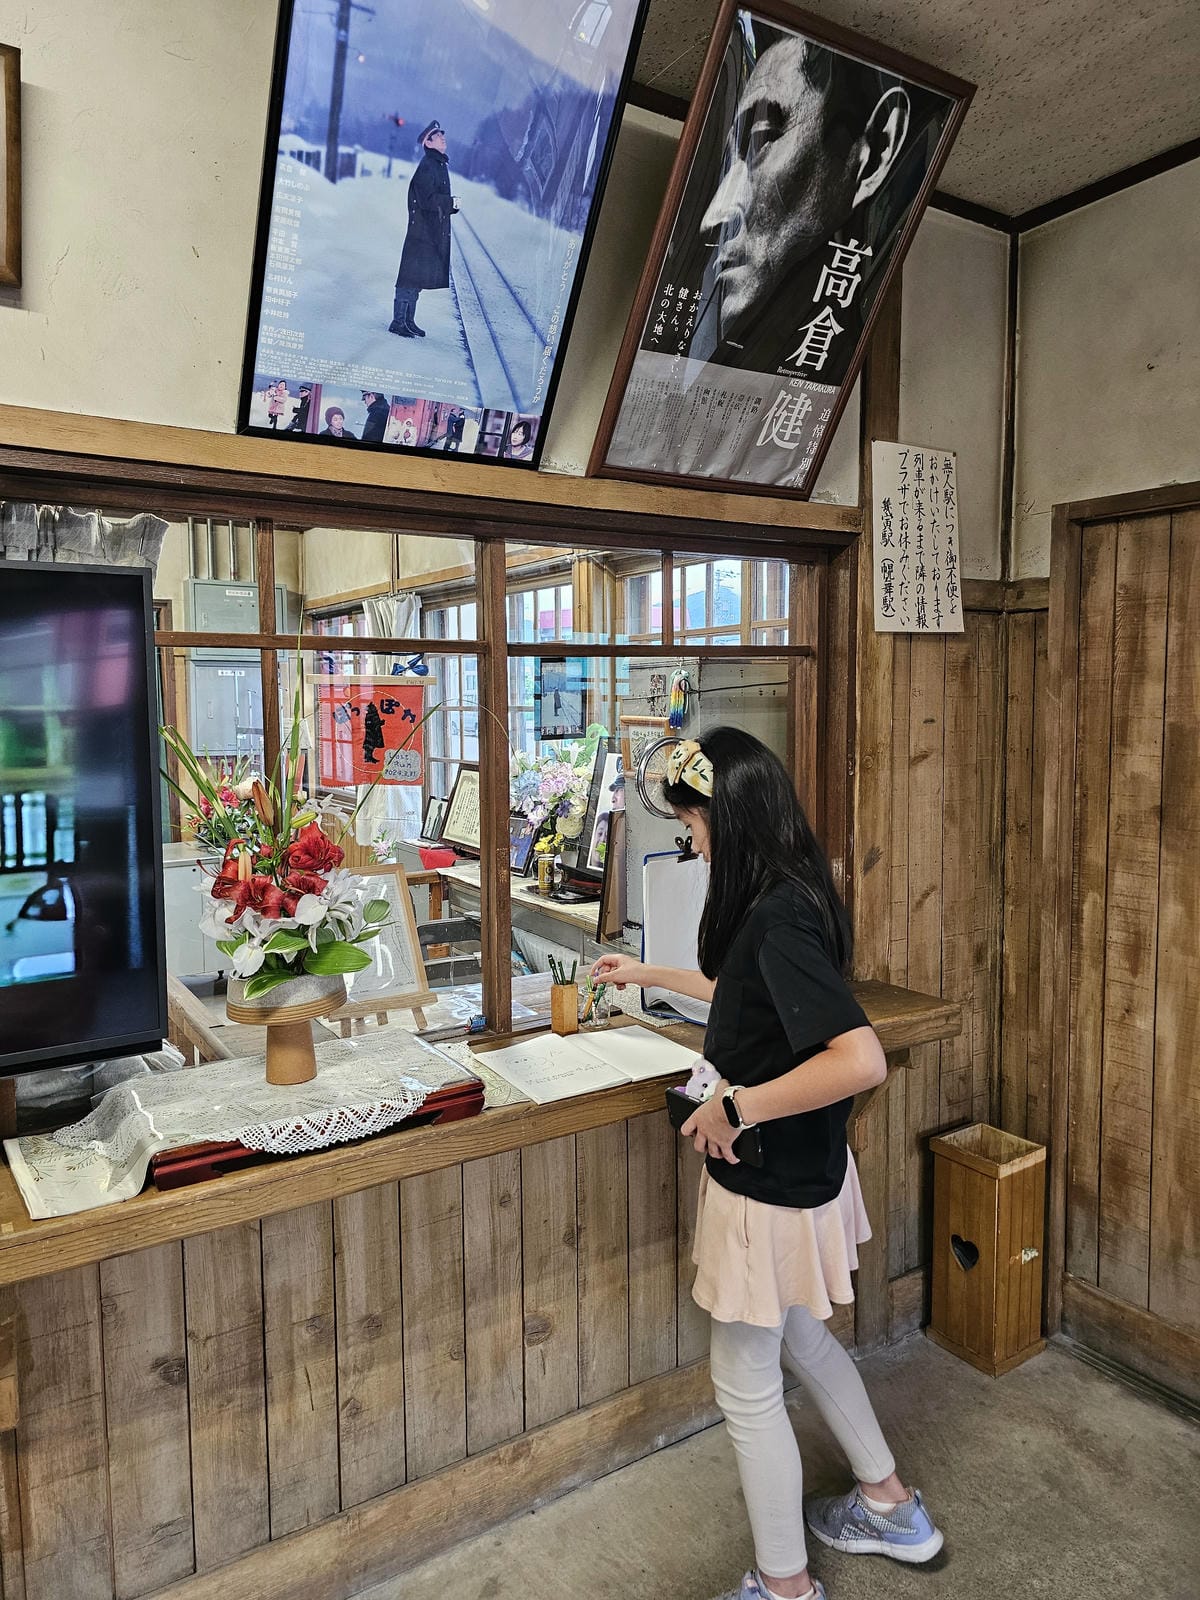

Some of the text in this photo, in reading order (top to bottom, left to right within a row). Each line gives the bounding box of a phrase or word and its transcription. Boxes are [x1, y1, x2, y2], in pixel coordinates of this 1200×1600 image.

[650, 283, 675, 344] 北の大地へ
[789, 378, 837, 395] KEN TAKAKURA
[756, 389, 813, 450] 健
[897, 449, 911, 627] プラザでお休みください
[912, 453, 929, 629] 列車が来るまで隣の情報
[928, 456, 944, 630] おかけいたしております
[941, 456, 959, 614] 無人駅につき御不便を
